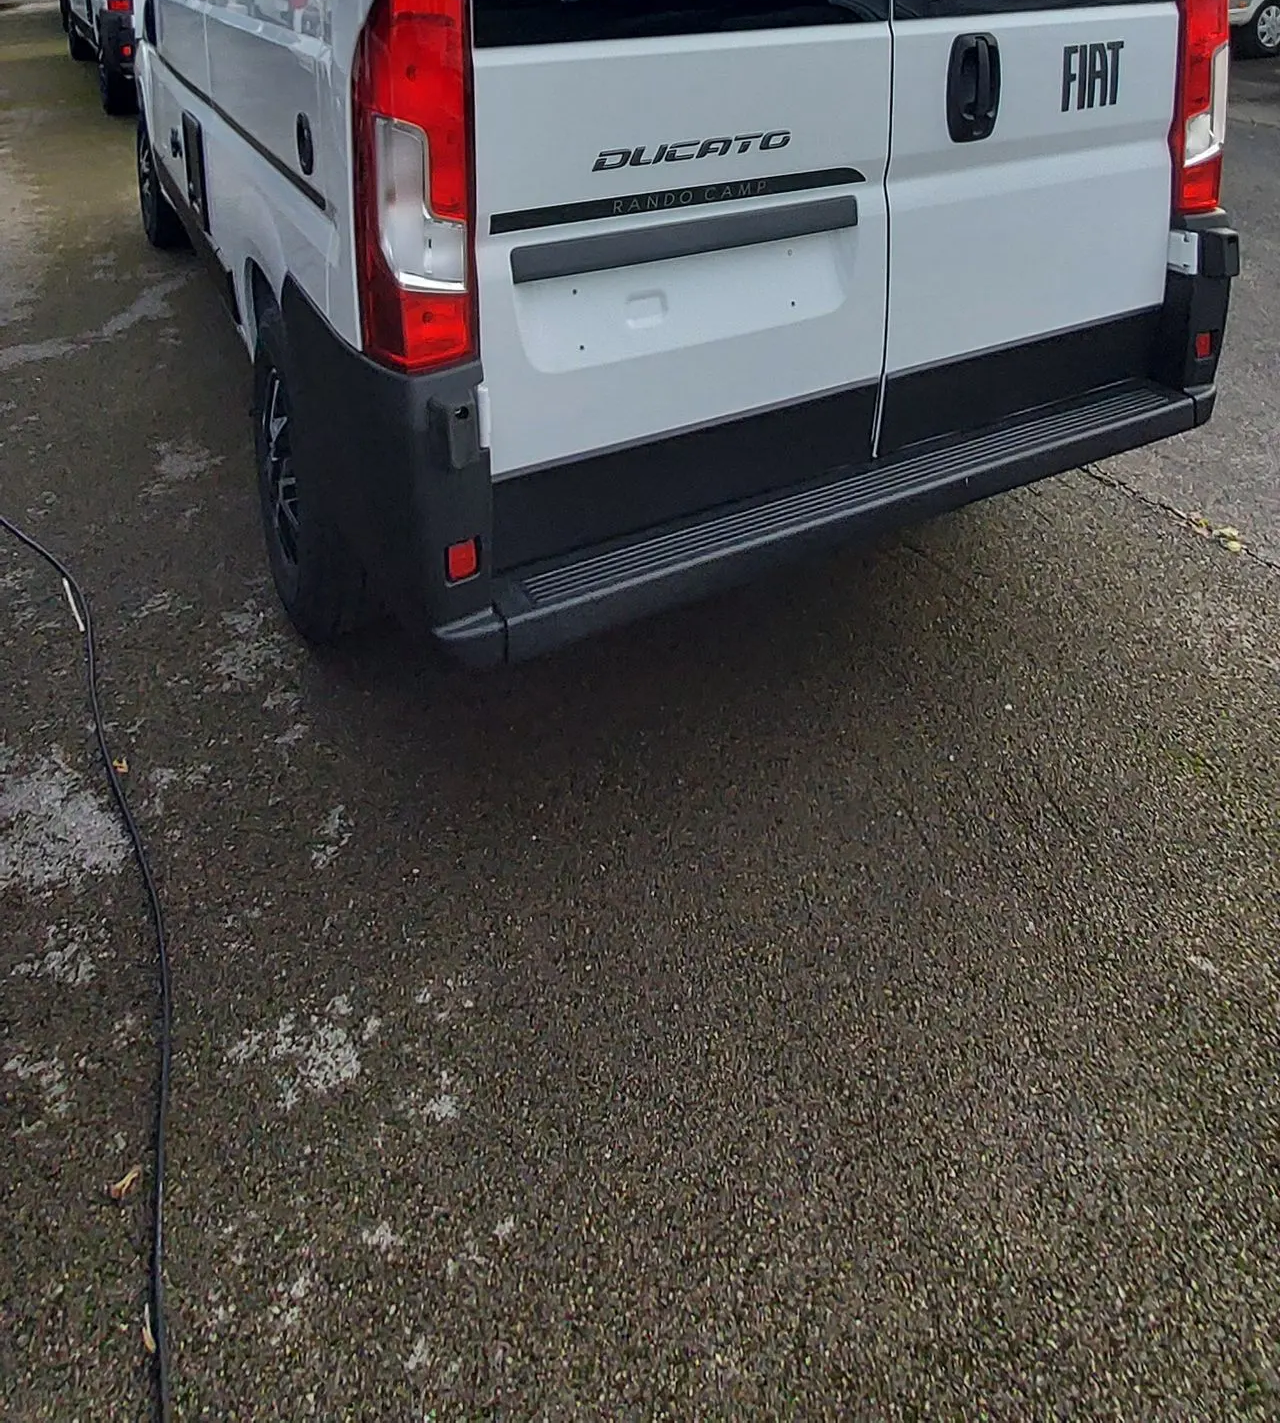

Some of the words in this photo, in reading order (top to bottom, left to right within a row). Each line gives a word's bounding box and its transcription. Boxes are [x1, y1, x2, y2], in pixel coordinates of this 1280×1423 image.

[1061, 40, 1124, 112] FIAT
[591, 129, 791, 172] DUCATO
[612, 190, 694, 214] RANDO
[704, 180, 768, 202] CAMP
